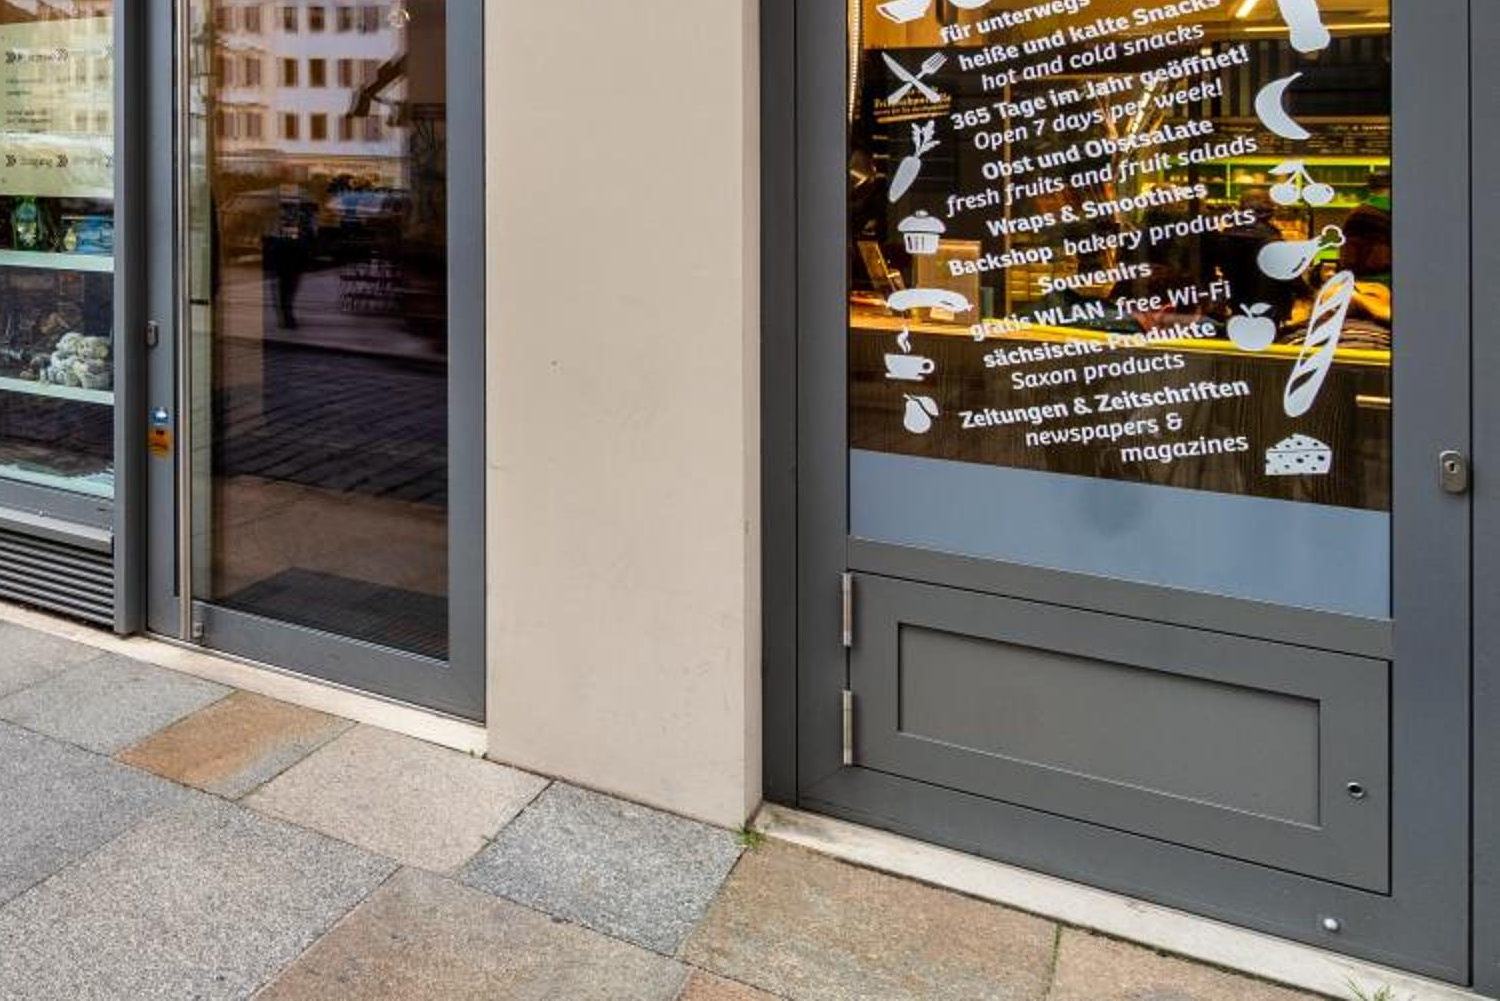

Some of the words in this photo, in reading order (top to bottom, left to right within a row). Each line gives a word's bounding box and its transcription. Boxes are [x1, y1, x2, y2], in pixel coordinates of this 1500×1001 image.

[940, 20, 970, 45] für
[959, 38, 1019, 72] heiße
[1023, 28, 1065, 55] und
[1070, 13, 1129, 44] kalte
[981, 66, 1018, 93] hot
[1022, 52, 1064, 82] and
[1070, 40, 1117, 69] cold
[1123, 22, 1205, 56] snacks
[950, 107, 992, 132] 365
[994, 95, 1047, 124] Tage
[1050, 84, 1080, 107] im
[1084, 73, 1132, 101] Jahr
[1140, 44, 1250, 90] geöffnet!
[974, 122, 1028, 153] Open
[1032, 118, 1046, 138] 7
[1052, 107, 1101, 137] days
[1106, 101, 1145, 128] per
[1154, 77, 1224, 111] week!
[946, 186, 1001, 218] fresh
[1004, 174, 1065, 208] fruits
[1071, 162, 1112, 188] and
[1118, 153, 1170, 187] fruit
[1178, 135, 1258, 164] salads
[982, 154, 1033, 181] Obst
[1038, 143, 1080, 169] und
[1084, 117, 1214, 160] Obstsalate
[986, 213, 1056, 239] Wraps
[1061, 207, 1079, 225] &
[1082, 183, 1208, 221] Smoothies
[948, 245, 1053, 280] Backshop
[1064, 226, 1143, 259] bakery
[1149, 207, 1256, 244] products
[1038, 261, 1152, 296] Souvenirs
[970, 313, 1032, 341] gratis
[1036, 303, 1106, 331] WLAN
[1115, 294, 1162, 322] free
[1168, 280, 1232, 309] Wi-Fi
[983, 337, 1102, 370] sächsische
[1106, 319, 1216, 352] Produkte
[1011, 365, 1076, 391] Saxon
[1082, 352, 1185, 388] products
[958, 397, 1070, 432] Zeitungen
[1073, 395, 1092, 414] &
[1098, 378, 1250, 413] Zeitschriften
[1026, 414, 1159, 448] newspapers
[1165, 412, 1183, 431] &
[1120, 434, 1249, 466] magazines
